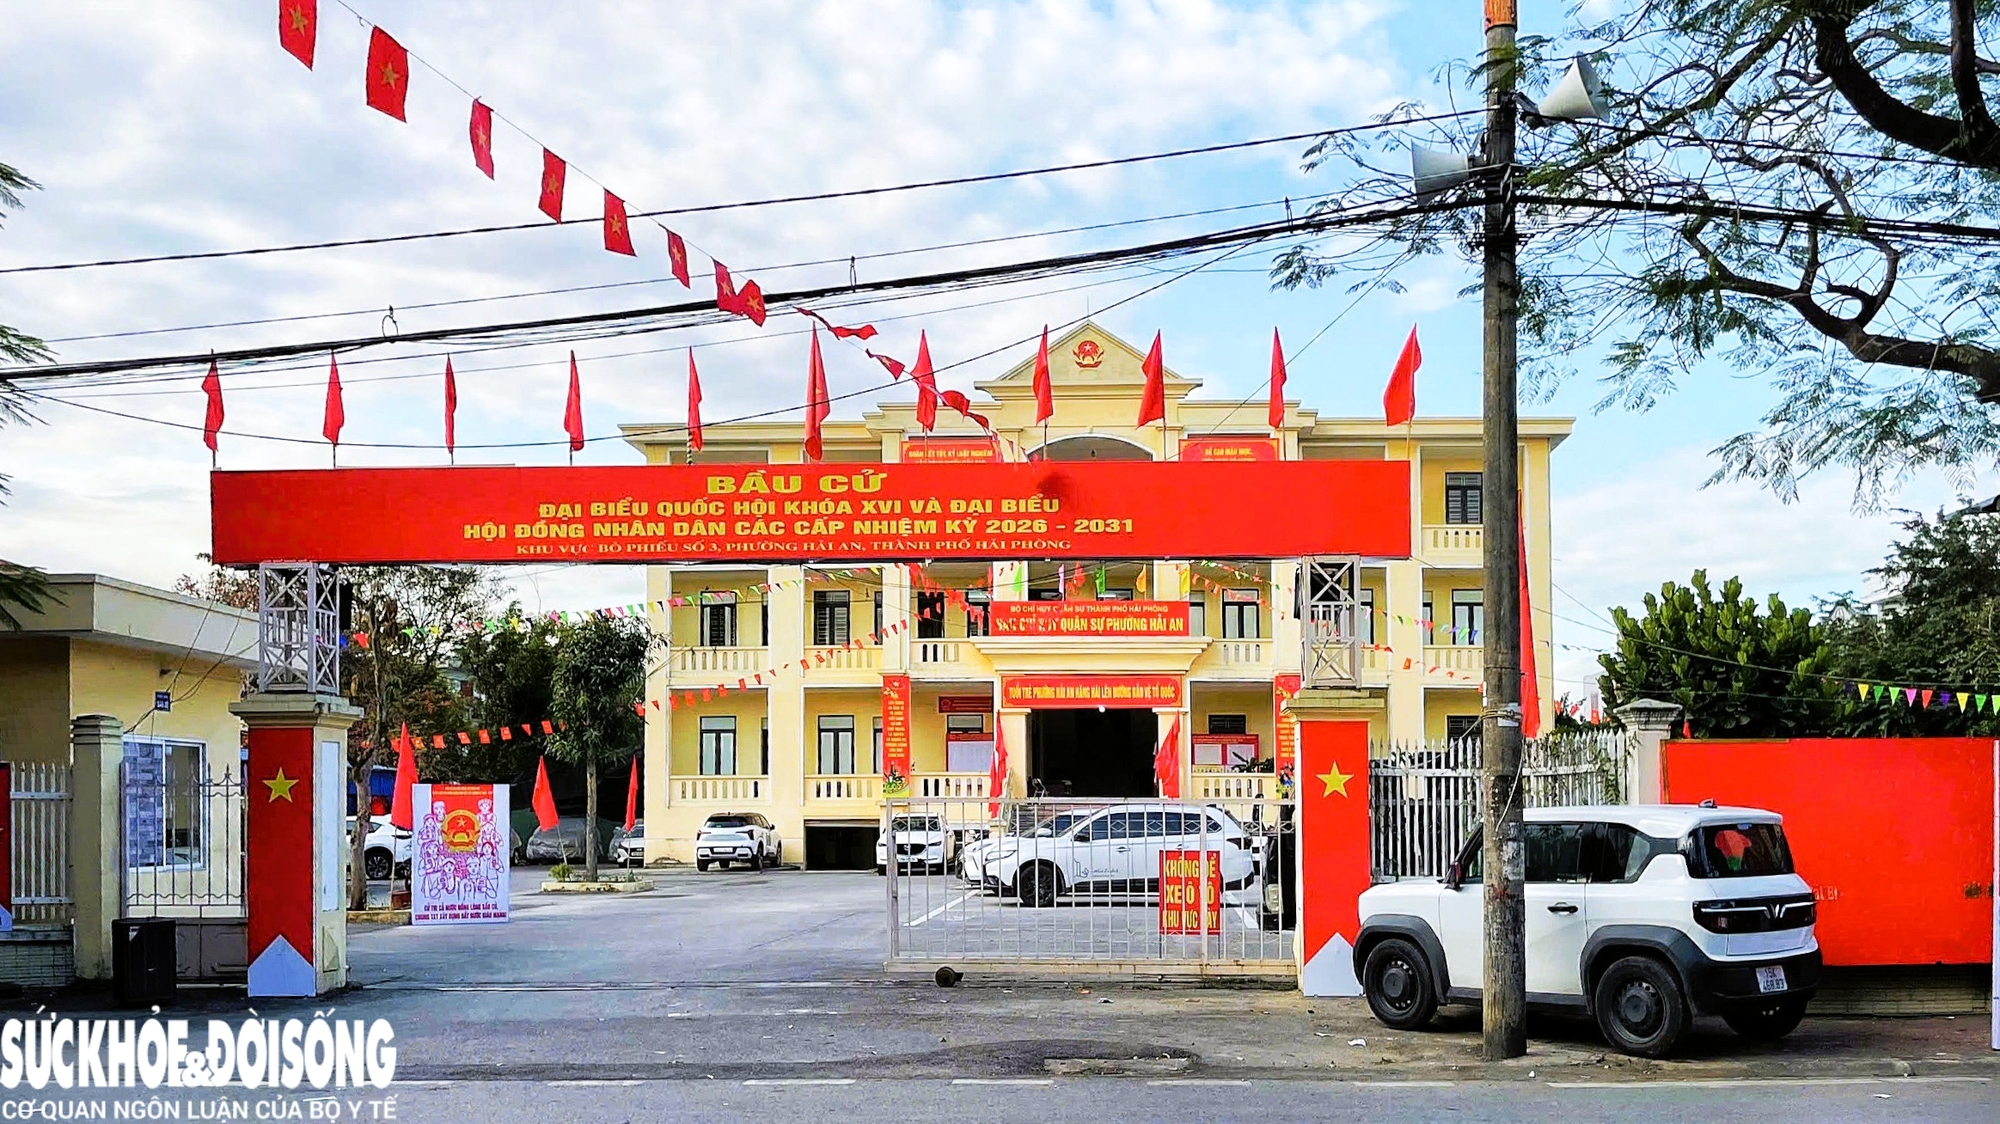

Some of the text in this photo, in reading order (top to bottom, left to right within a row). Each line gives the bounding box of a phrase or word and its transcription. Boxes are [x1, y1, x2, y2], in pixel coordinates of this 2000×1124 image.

[707, 469, 888, 494] BẦU CỬ
[539, 494, 1060, 520] ĐẠI BIỂU QUỐC HỘI KHÓA XVI VÀ ĐẠI BIỂU
[464, 522, 506, 542] HỘI
[514, 520, 585, 538] ĐỒNG
[593, 520, 665, 538] NHÂN
[673, 519, 726, 536] DÂN
[734, 518, 785, 536] CÁC
[794, 516, 845, 535] CẤP
[853, 517, 938, 537] NHIỆM
[945, 517, 978, 534] KỲ
[985, 518, 1048, 534] 2026
[1073, 518, 1134, 534] 2031
[516, 545, 554, 554] KHU
[626, 540, 679, 552] PHIẾU
[682, 540, 705, 552] SỐ
[726, 540, 798, 552] PHƯỜNG
[803, 540, 834, 552] HẢI
[871, 539, 930, 551] THÀNH
[935, 537, 970, 550] PHỐ
[976, 538, 1006, 550] HẢI
[1011, 538, 1072, 550] PHÒNG
[1036, 604, 1050, 612] HUY
[1086, 604, 1110, 612] THÀNH
[1112, 603, 1128, 612] PHỐ
[1143, 604, 1168, 612] PHÒNG
[1060, 615, 1088, 632] QUÂN
[1090, 616, 1106, 634] SỰ
[1106, 615, 1148, 632] PHƯỜNG
[1150, 613, 1166, 632] HẢI
[1168, 618, 1184, 632] AN
[1166, 856, 1200, 878] KHÔNG
[1166, 884, 1182, 904] XE
[1186, 881, 1195, 904] Ô
[1163, 910, 1180, 928] KHU
[1205, 908, 1218, 928] ÀY
